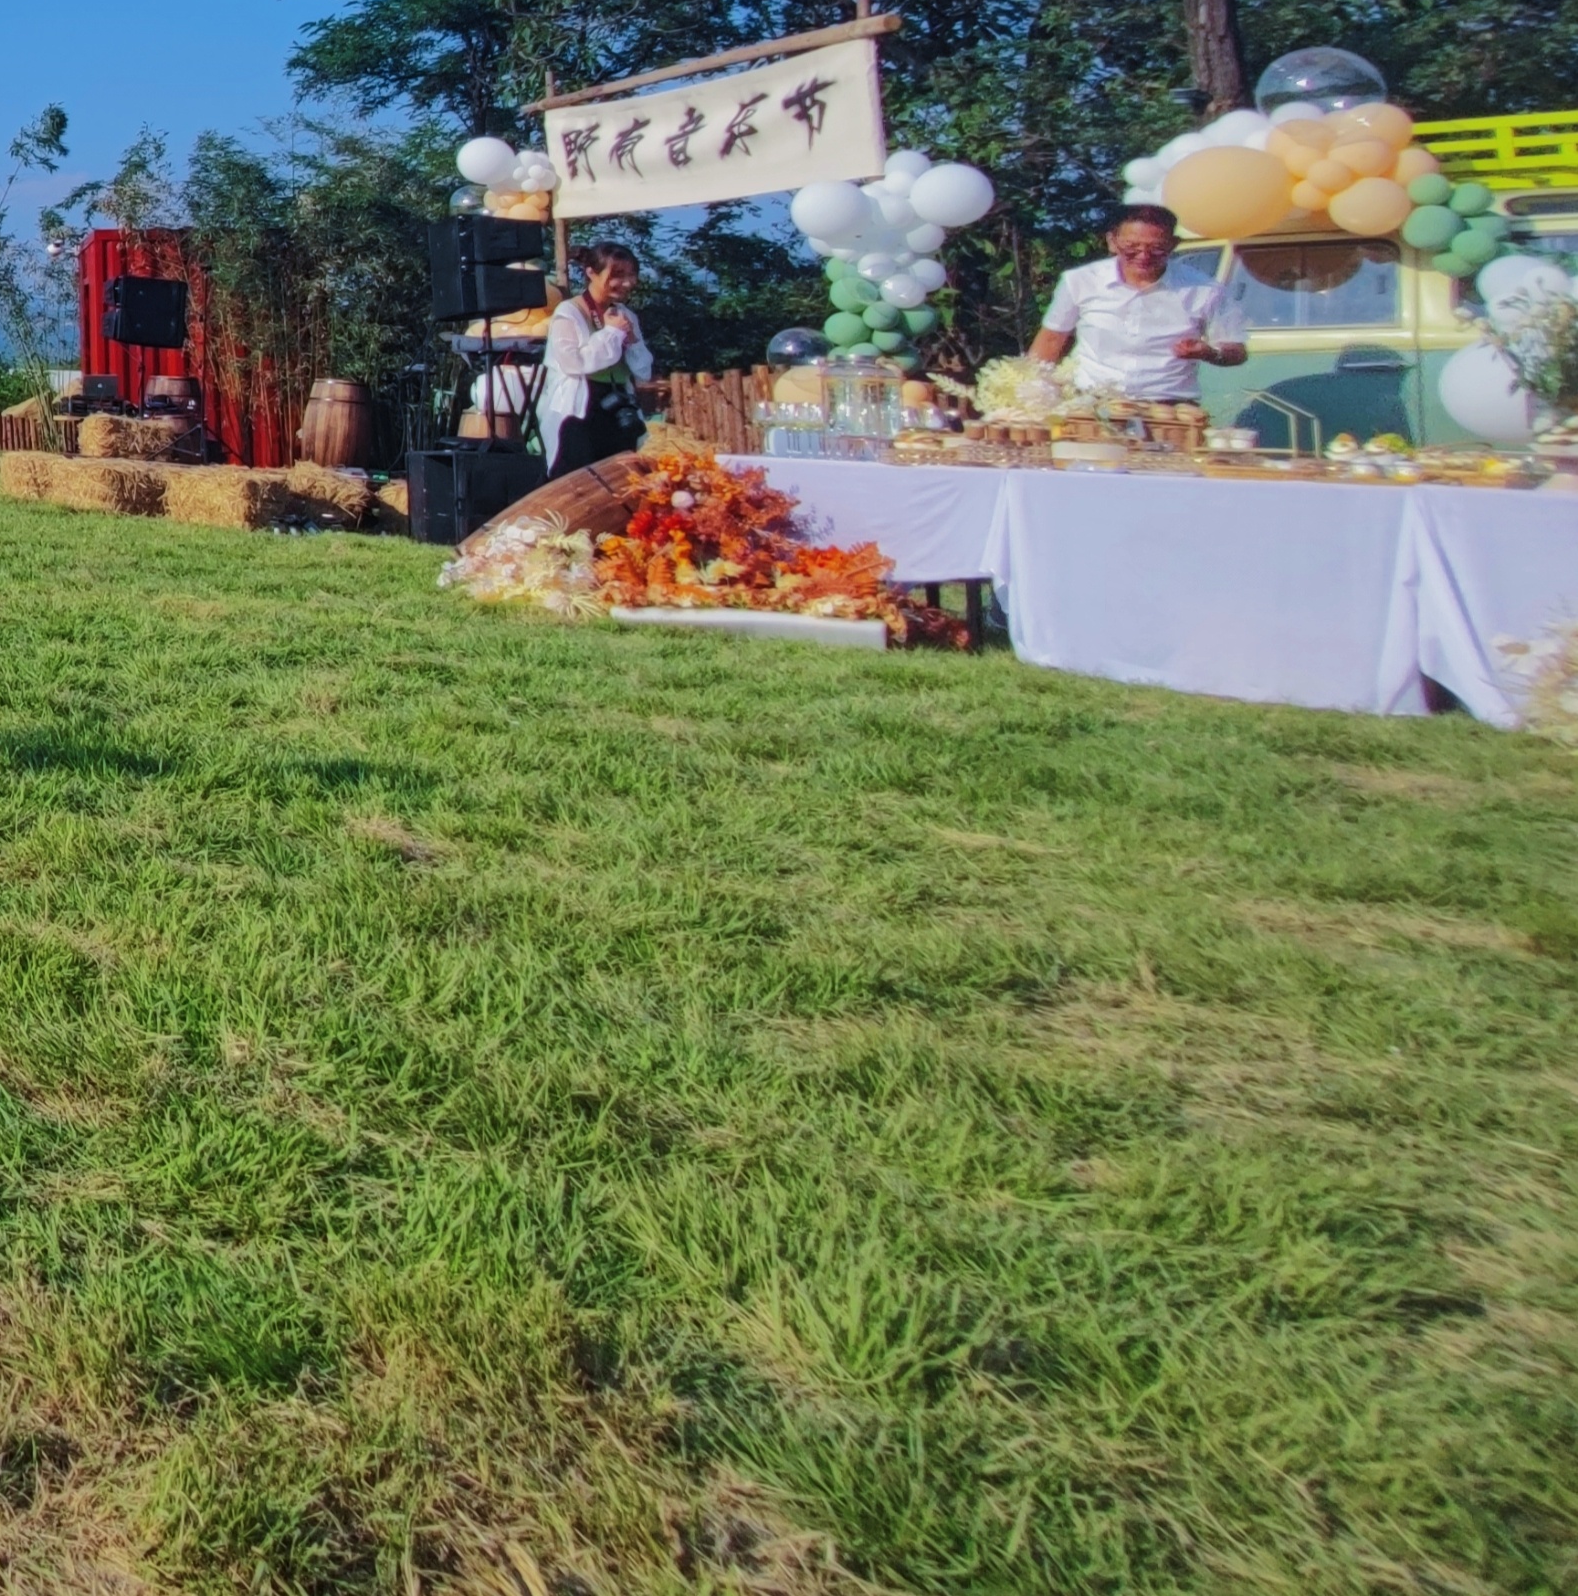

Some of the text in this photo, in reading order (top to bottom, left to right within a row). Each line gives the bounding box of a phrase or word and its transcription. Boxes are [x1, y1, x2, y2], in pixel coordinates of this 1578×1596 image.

[561, 76, 838, 183] 野有音乐节
